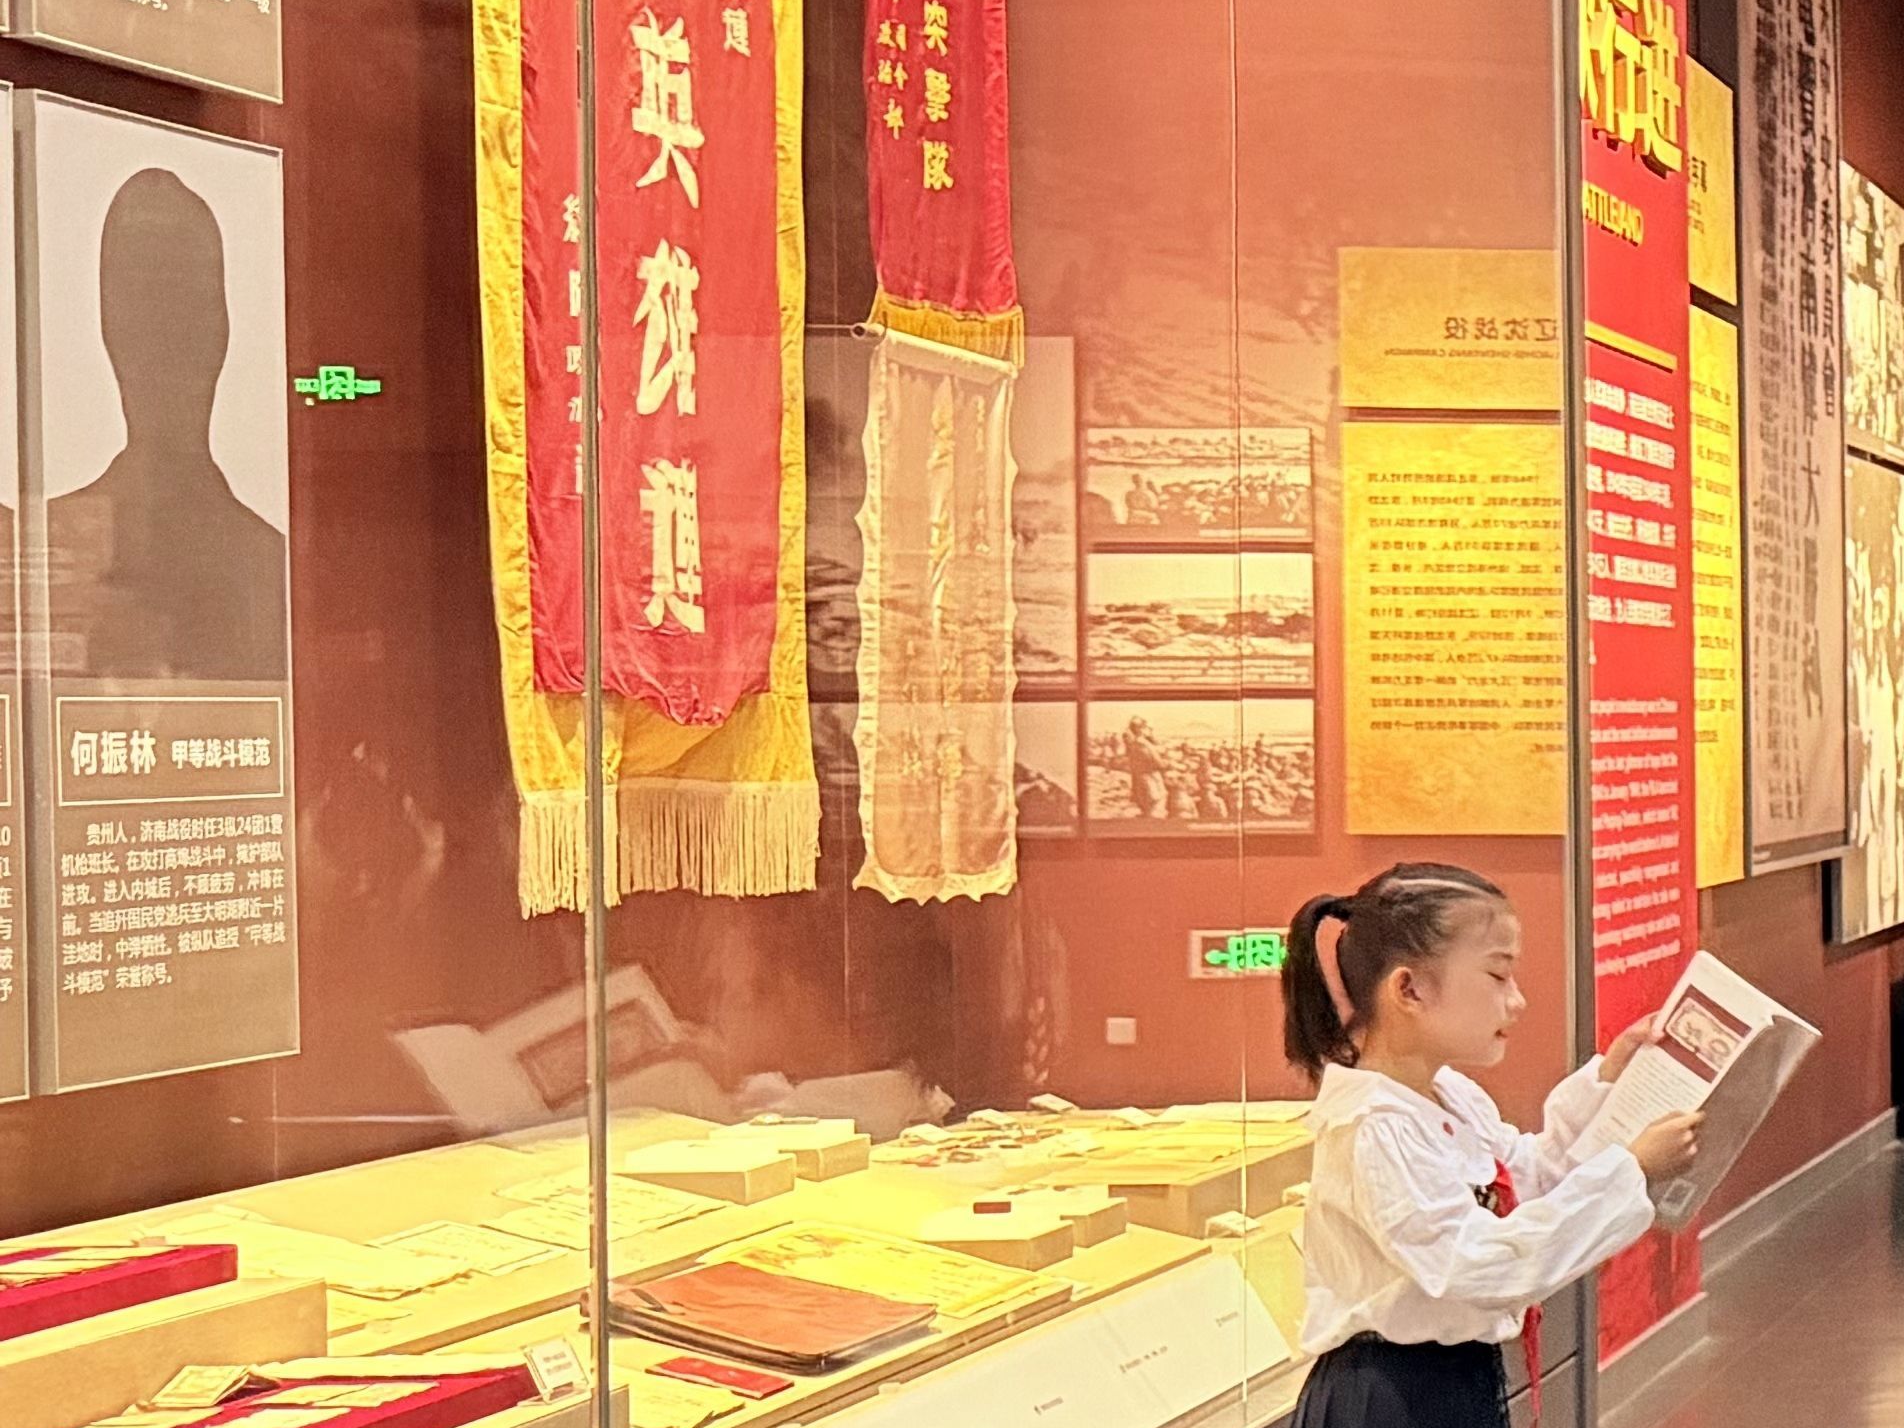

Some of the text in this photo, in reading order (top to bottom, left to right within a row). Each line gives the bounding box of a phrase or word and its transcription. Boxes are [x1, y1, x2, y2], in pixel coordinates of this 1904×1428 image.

[71, 729, 271, 776] 何振林 甲等战斗模范
